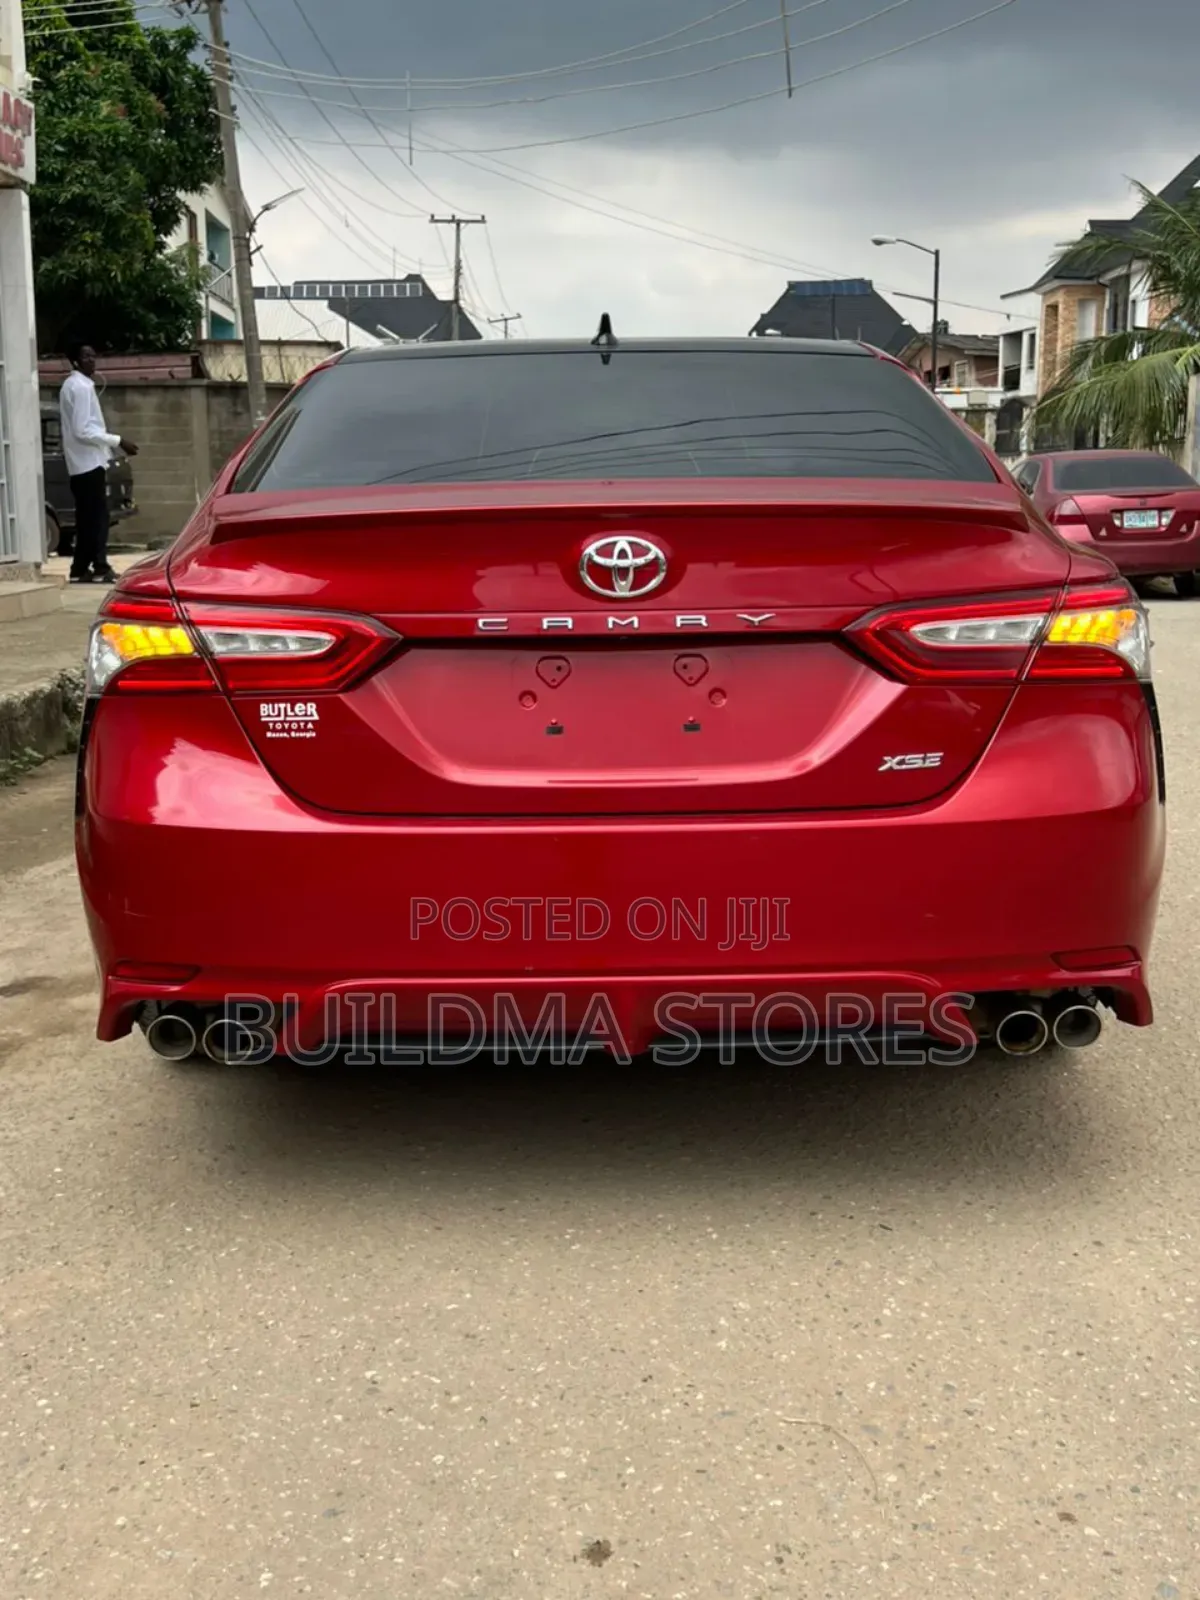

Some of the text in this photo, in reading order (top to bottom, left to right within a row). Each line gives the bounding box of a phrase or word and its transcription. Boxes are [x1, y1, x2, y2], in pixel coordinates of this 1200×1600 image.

[477, 612, 776, 630] CAMRY
[268, 722, 314, 730] TOYOTA
[878, 752, 944, 771] XSE
